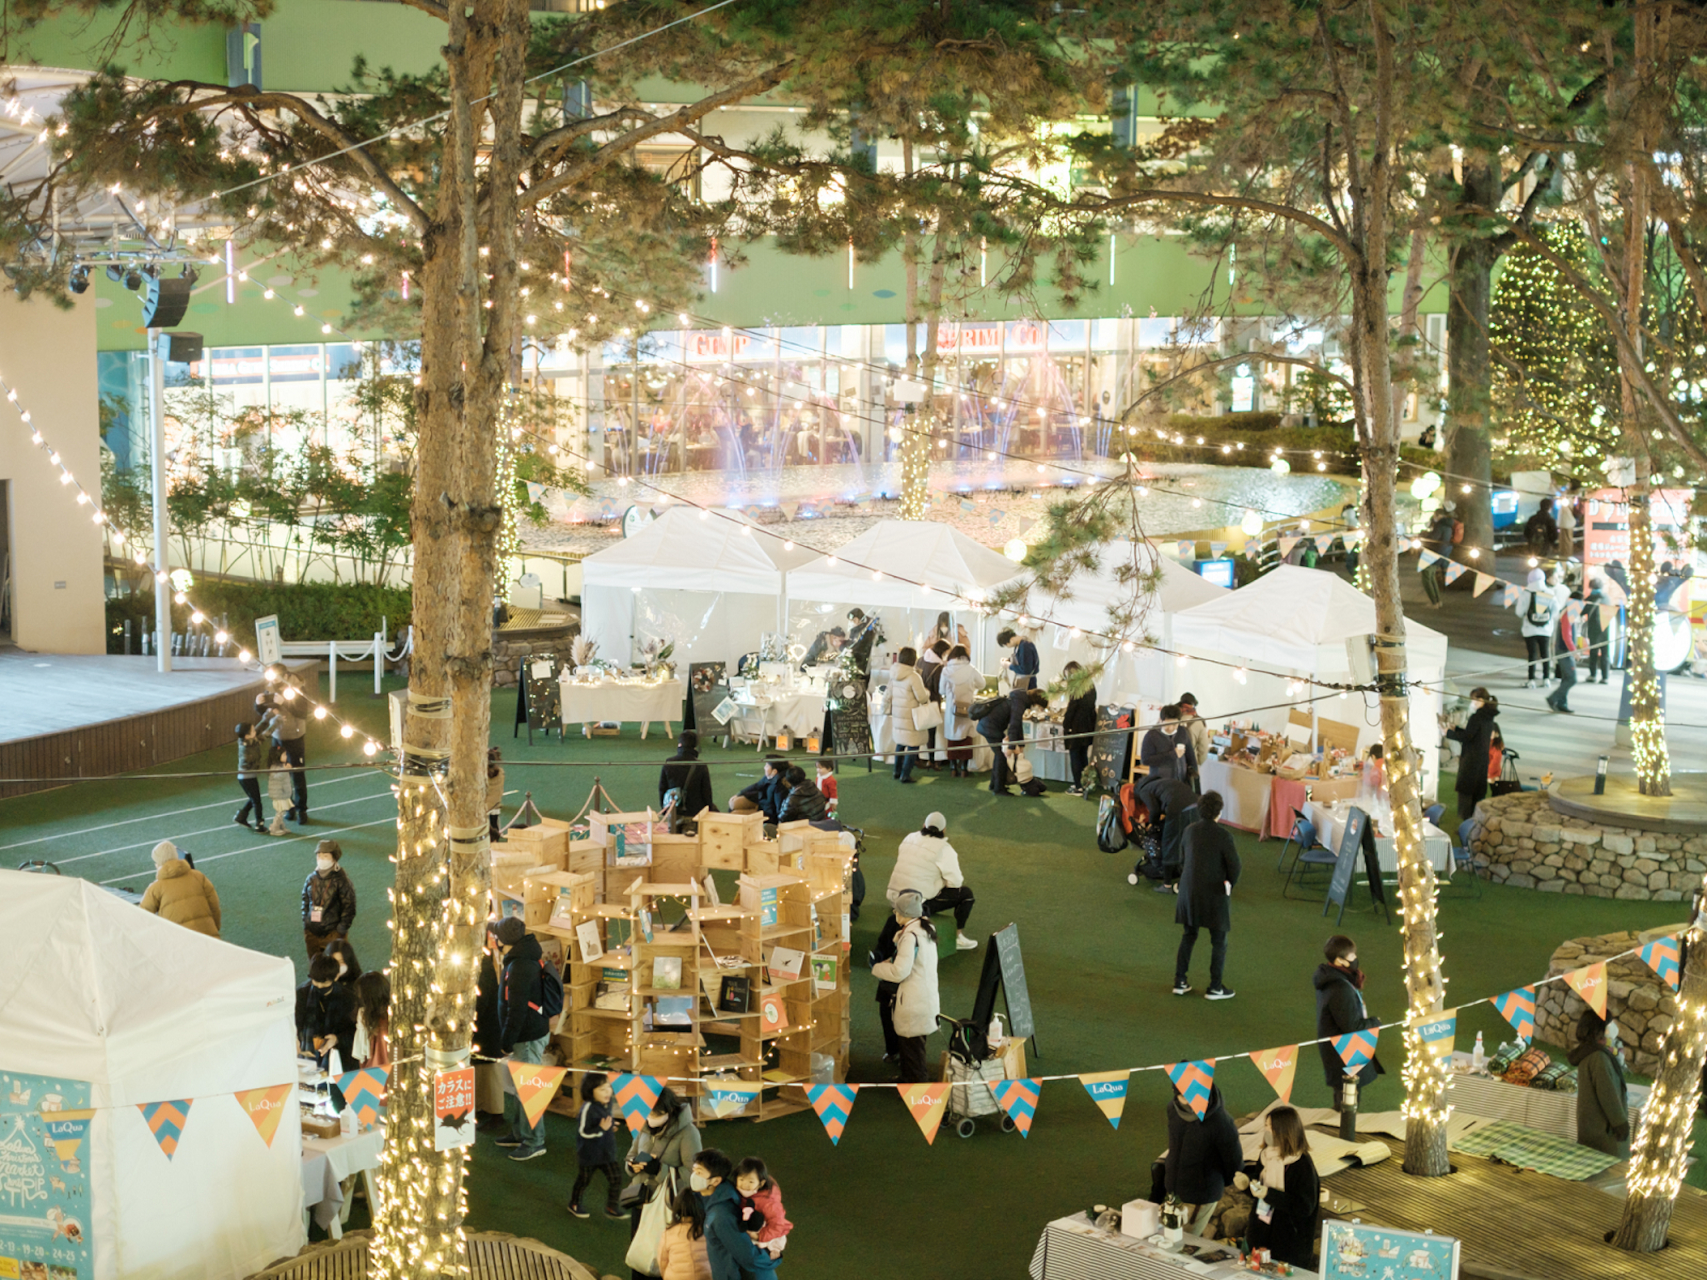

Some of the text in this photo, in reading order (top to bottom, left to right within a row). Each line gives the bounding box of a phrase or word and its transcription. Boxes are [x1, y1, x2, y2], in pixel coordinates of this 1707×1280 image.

[1576, 977, 1602, 990] LaQua
[1423, 1023, 1451, 1036] LaQua
[1263, 1058, 1292, 1070] LaQua
[437, 1078, 472, 1095] カラスに
[519, 1075, 554, 1089] LaQua
[1092, 1082, 1124, 1094] LaQua
[717, 1091, 750, 1103] LaQua
[911, 1095, 942, 1106] LaQua
[248, 1099, 281, 1112] LaQua
[52, 1121, 83, 1134] LaQua
